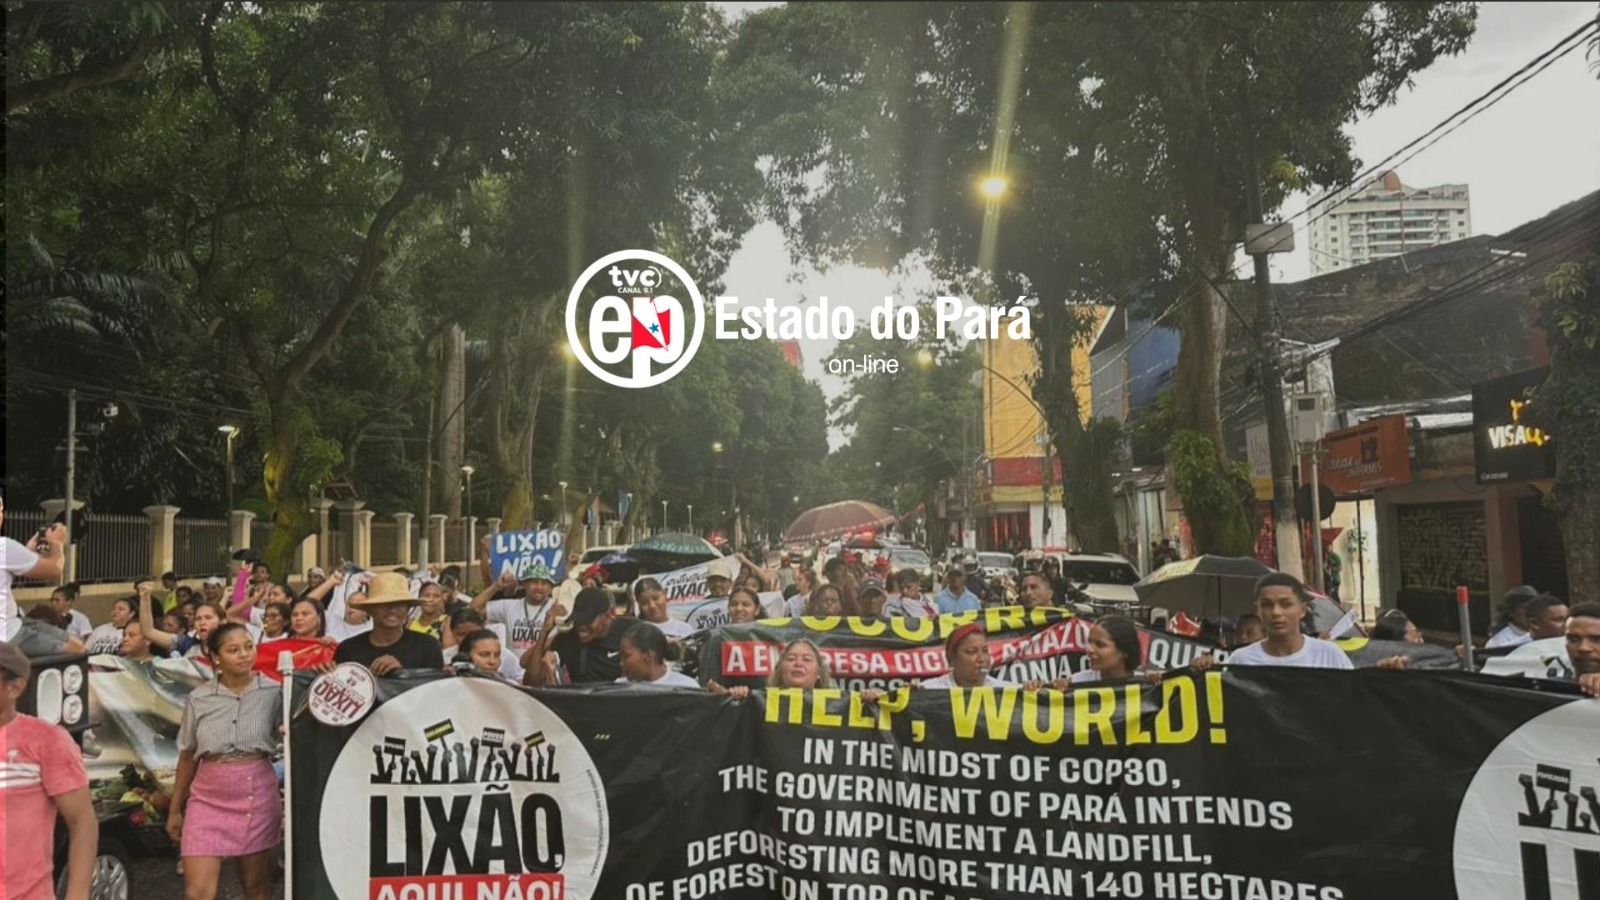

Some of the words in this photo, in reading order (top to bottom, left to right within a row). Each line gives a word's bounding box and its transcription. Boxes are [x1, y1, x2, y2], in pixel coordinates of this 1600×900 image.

[727, 645, 747, 672] A
[765, 683, 925, 742] HELP,
[949, 671, 1227, 746] WORLD!
[803, 738, 834, 765] IN
[842, 740, 894, 770] THE
[901, 747, 1001, 781] MIDST
[1010, 755, 1051, 782] OF
[1059, 757, 1181, 789] COP30,
[718, 764, 768, 794] THE
[775, 771, 982, 815] GOVERNMENT
[989, 790, 1031, 818] OF
[1039, 792, 1127, 824] PARÁ
[1135, 796, 1294, 831] INTENDS
[777, 806, 816, 835] TO
[823, 810, 1007, 853] IMPLEMENT
[1013, 829, 1037, 855] A
[1045, 829, 1212, 865] LANDFILL,
[477, 874, 560, 900] NÃO!
[626, 882, 664, 900] OF
[672, 863, 778, 900] FOREST
[782, 876, 819, 900] ON
[826, 883, 888, 900] TOP
[687, 829, 880, 875] DEFORESTING
[889, 851, 977, 888] MORE
[984, 862, 1073, 897] THAN
[1081, 870, 1144, 899] 140
[1154, 871, 1344, 900] HECTARES
